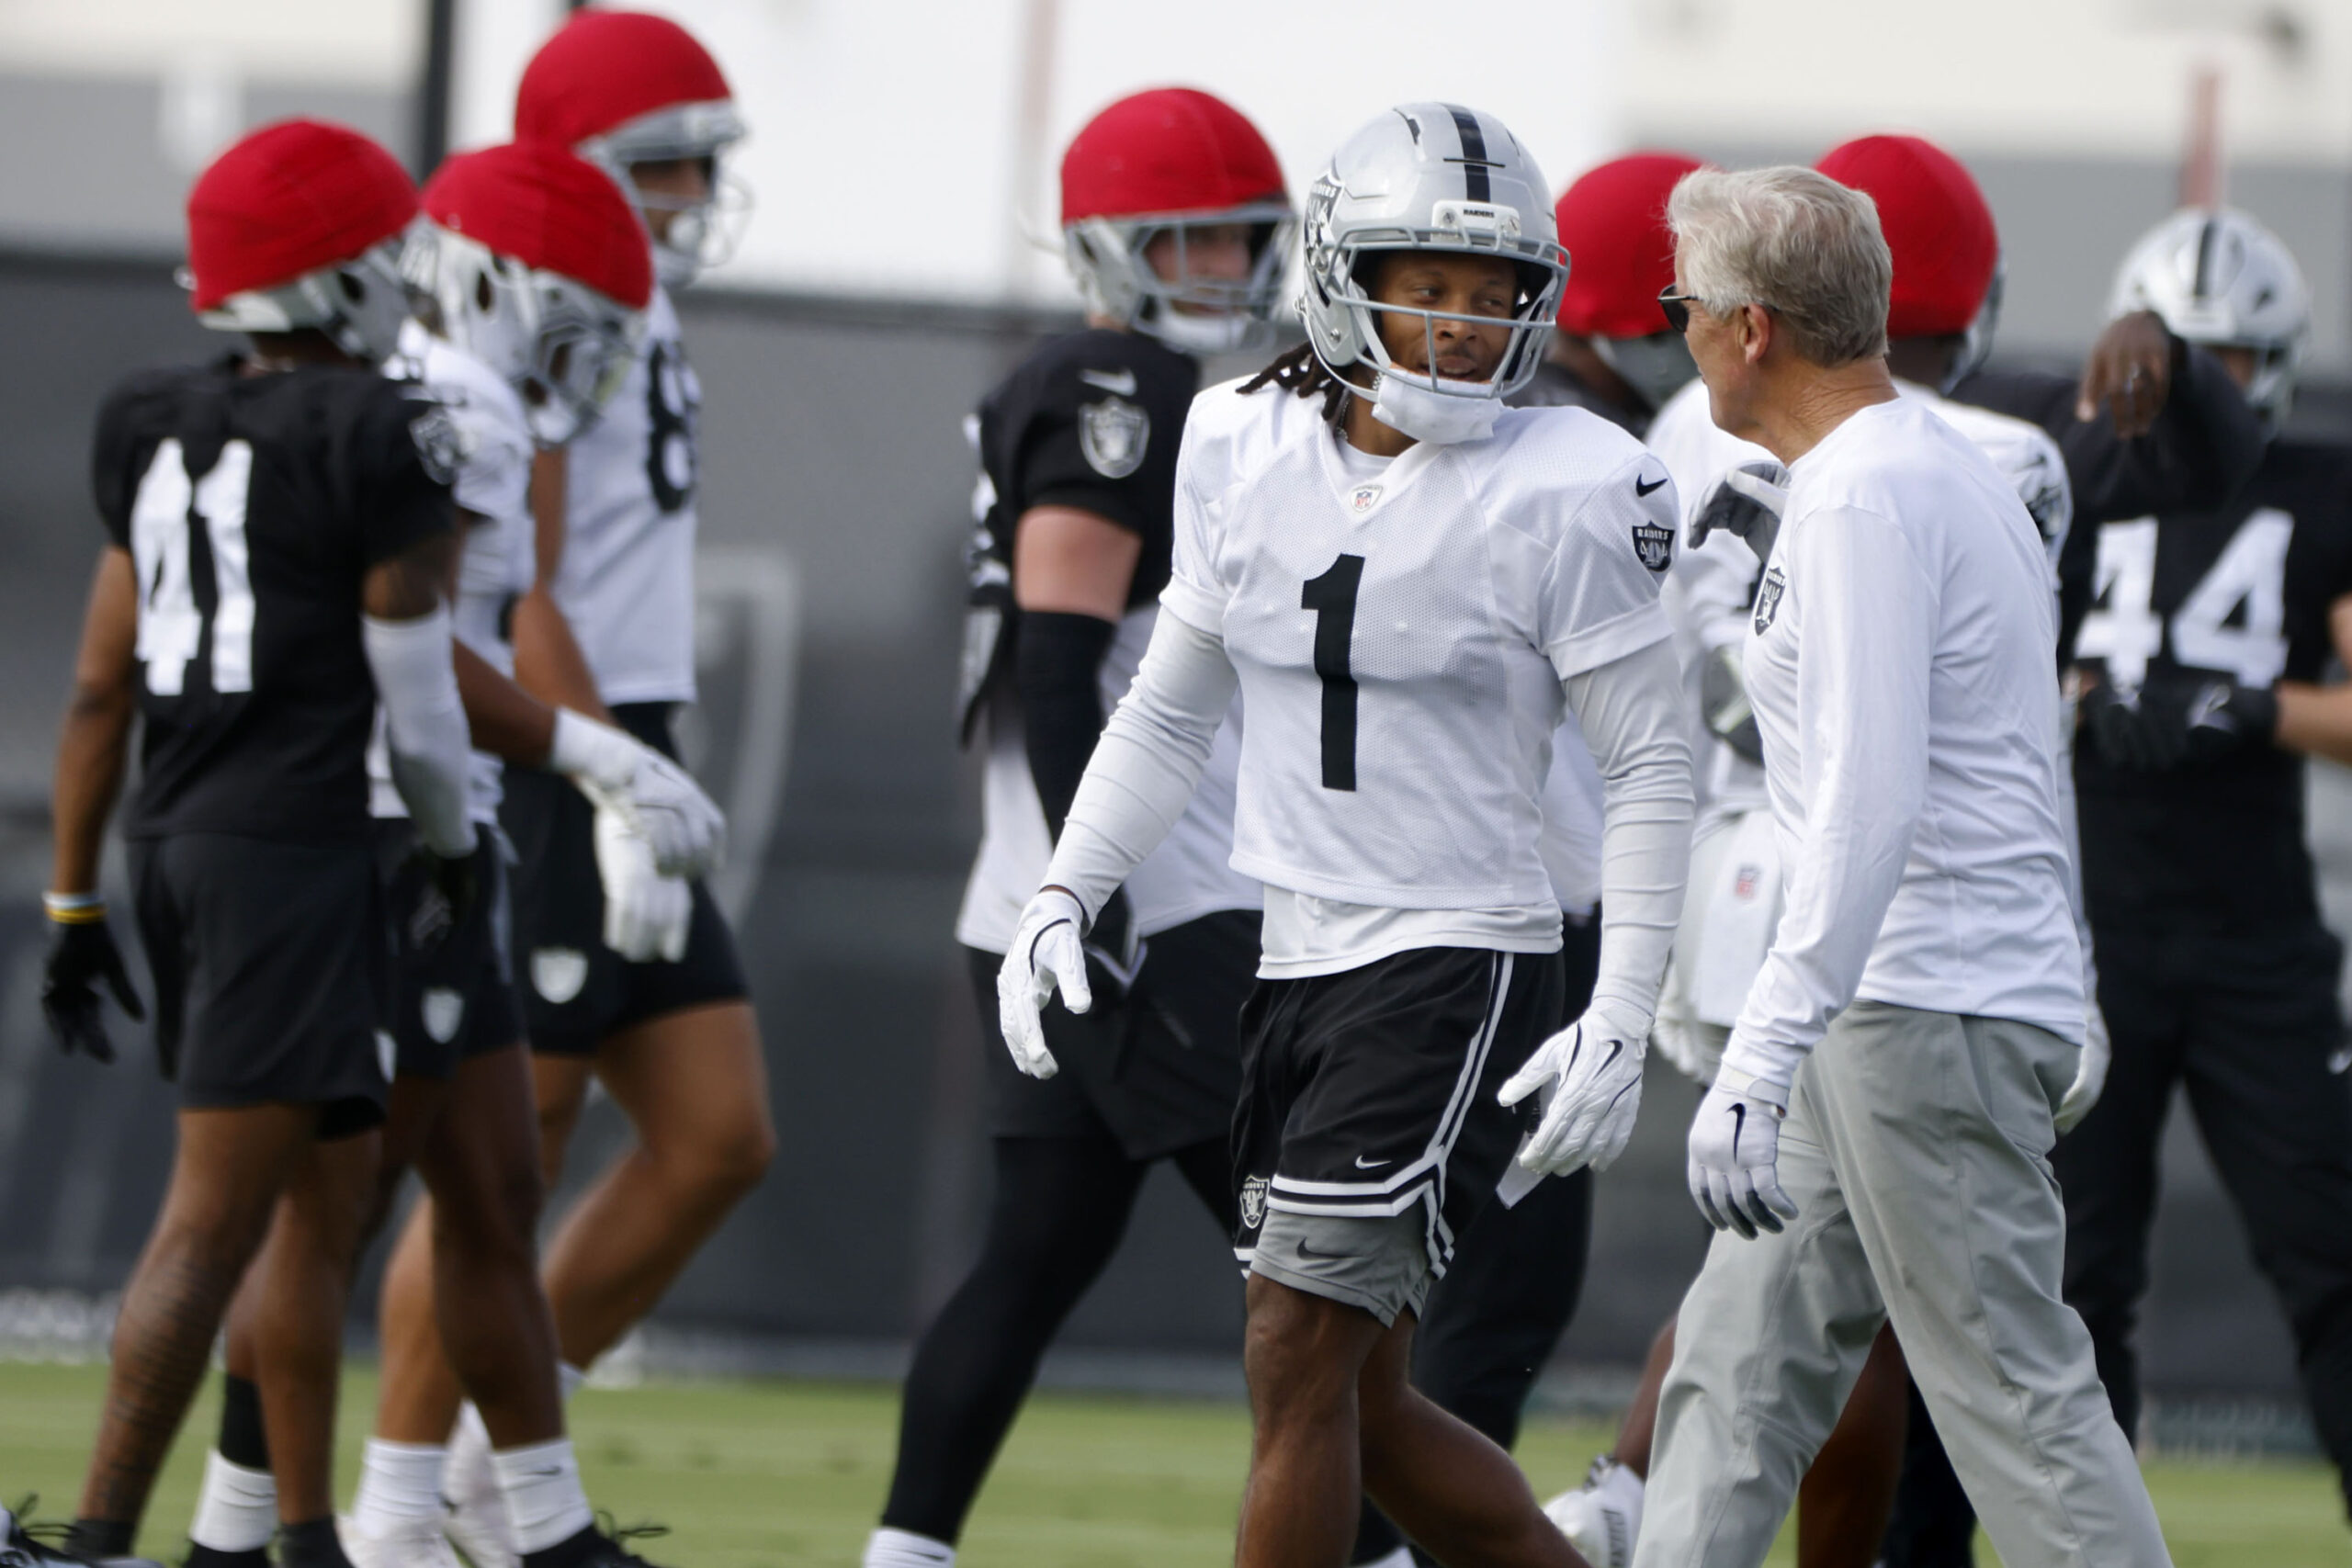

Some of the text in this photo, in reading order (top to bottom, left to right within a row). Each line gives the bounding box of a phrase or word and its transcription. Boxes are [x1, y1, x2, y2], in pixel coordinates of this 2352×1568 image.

[132, 439, 254, 695] 41
[1301, 554, 1365, 793] 1
[2074, 506, 2294, 703] 44
